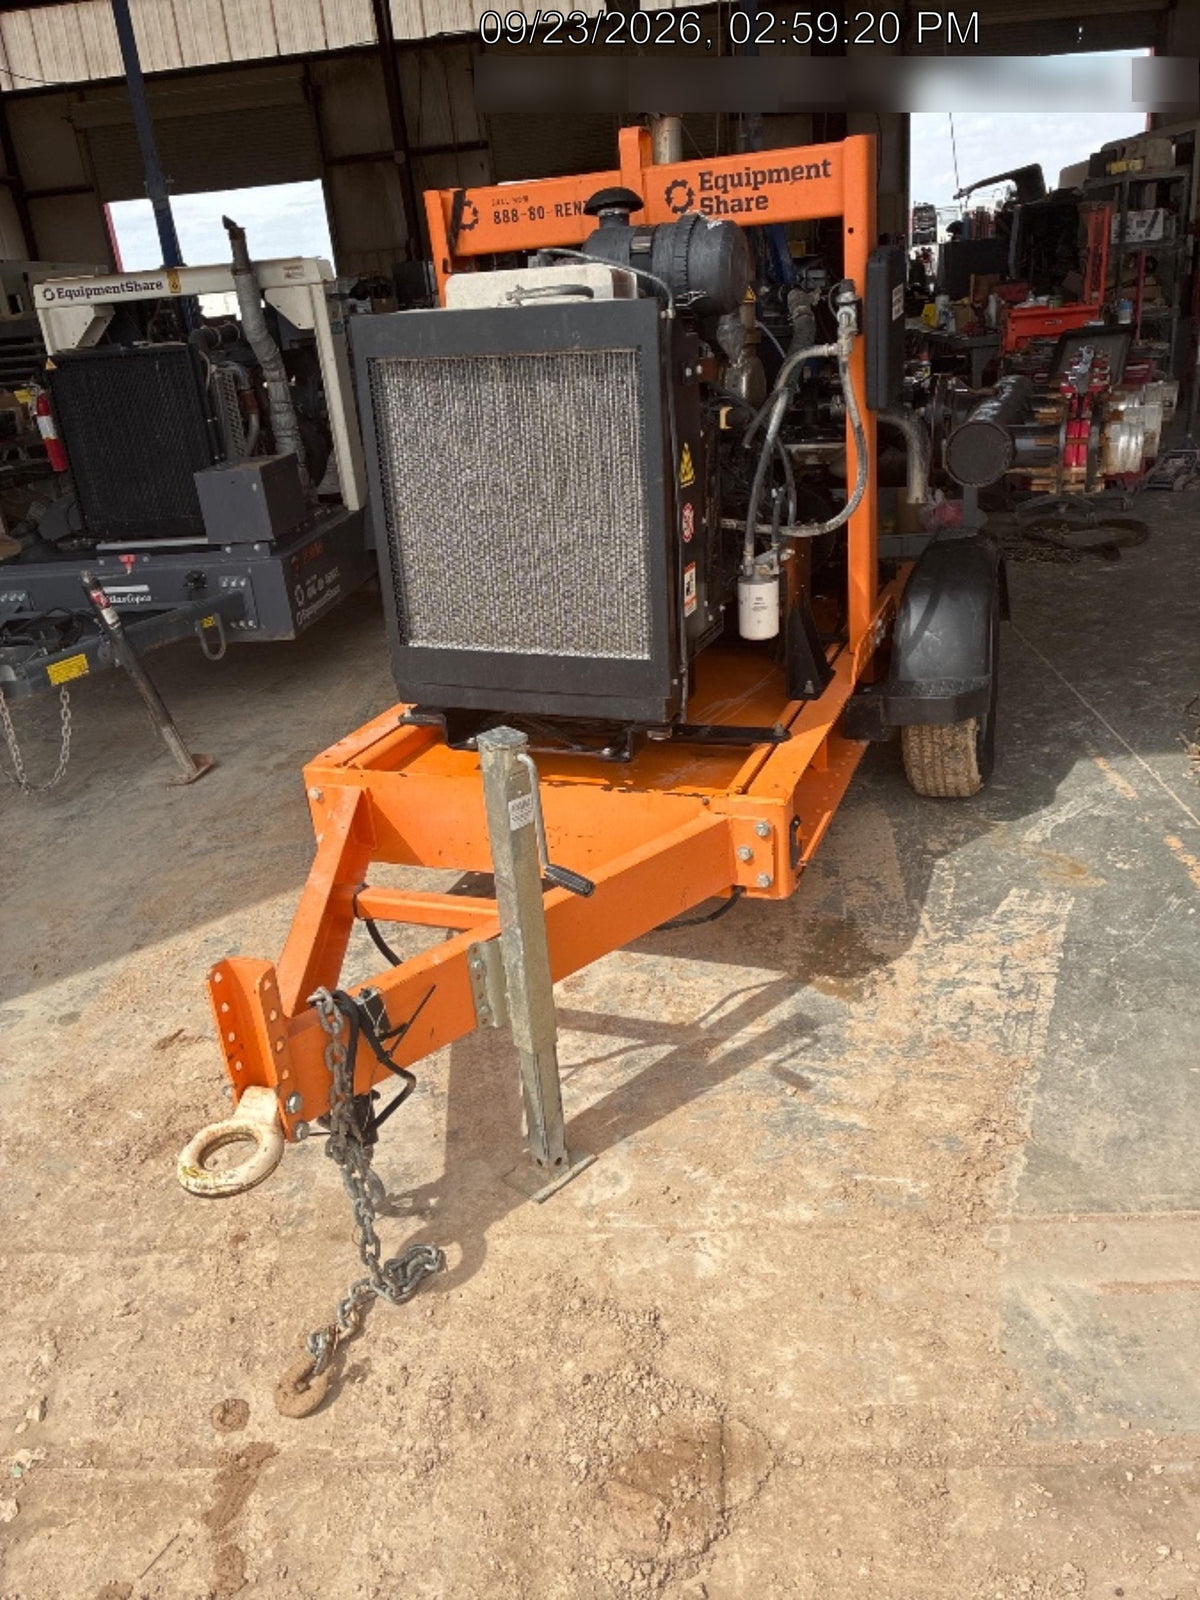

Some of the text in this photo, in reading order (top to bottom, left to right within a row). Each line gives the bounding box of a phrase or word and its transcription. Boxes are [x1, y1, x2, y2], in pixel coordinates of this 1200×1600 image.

[698, 159, 831, 193] Equipment
[699, 194, 769, 215] Share
[56, 281, 163, 300] EquipmentShare
